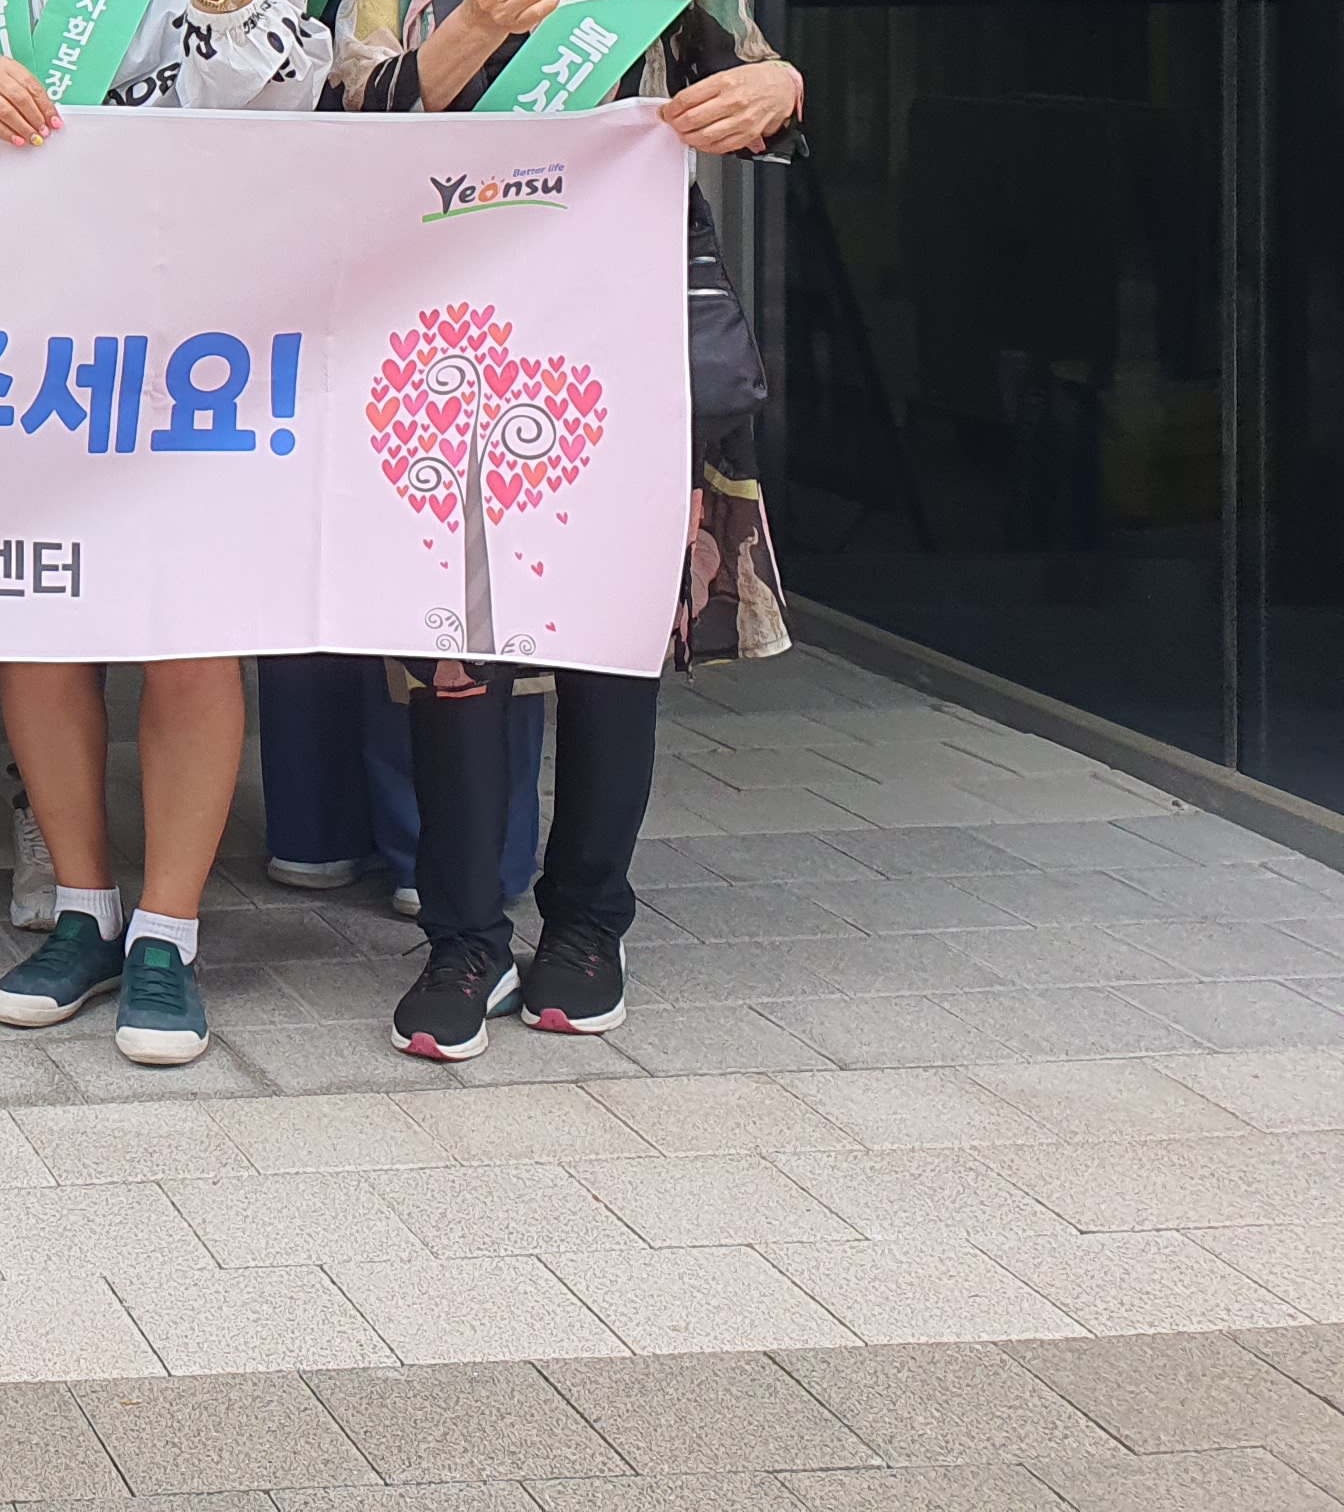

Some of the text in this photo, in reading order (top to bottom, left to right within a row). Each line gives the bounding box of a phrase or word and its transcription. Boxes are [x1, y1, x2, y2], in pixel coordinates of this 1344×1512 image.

[513, 16, 619, 112] 복지사
[512, 163, 565, 178] Better life
[429, 173, 563, 215] Yeonsu
